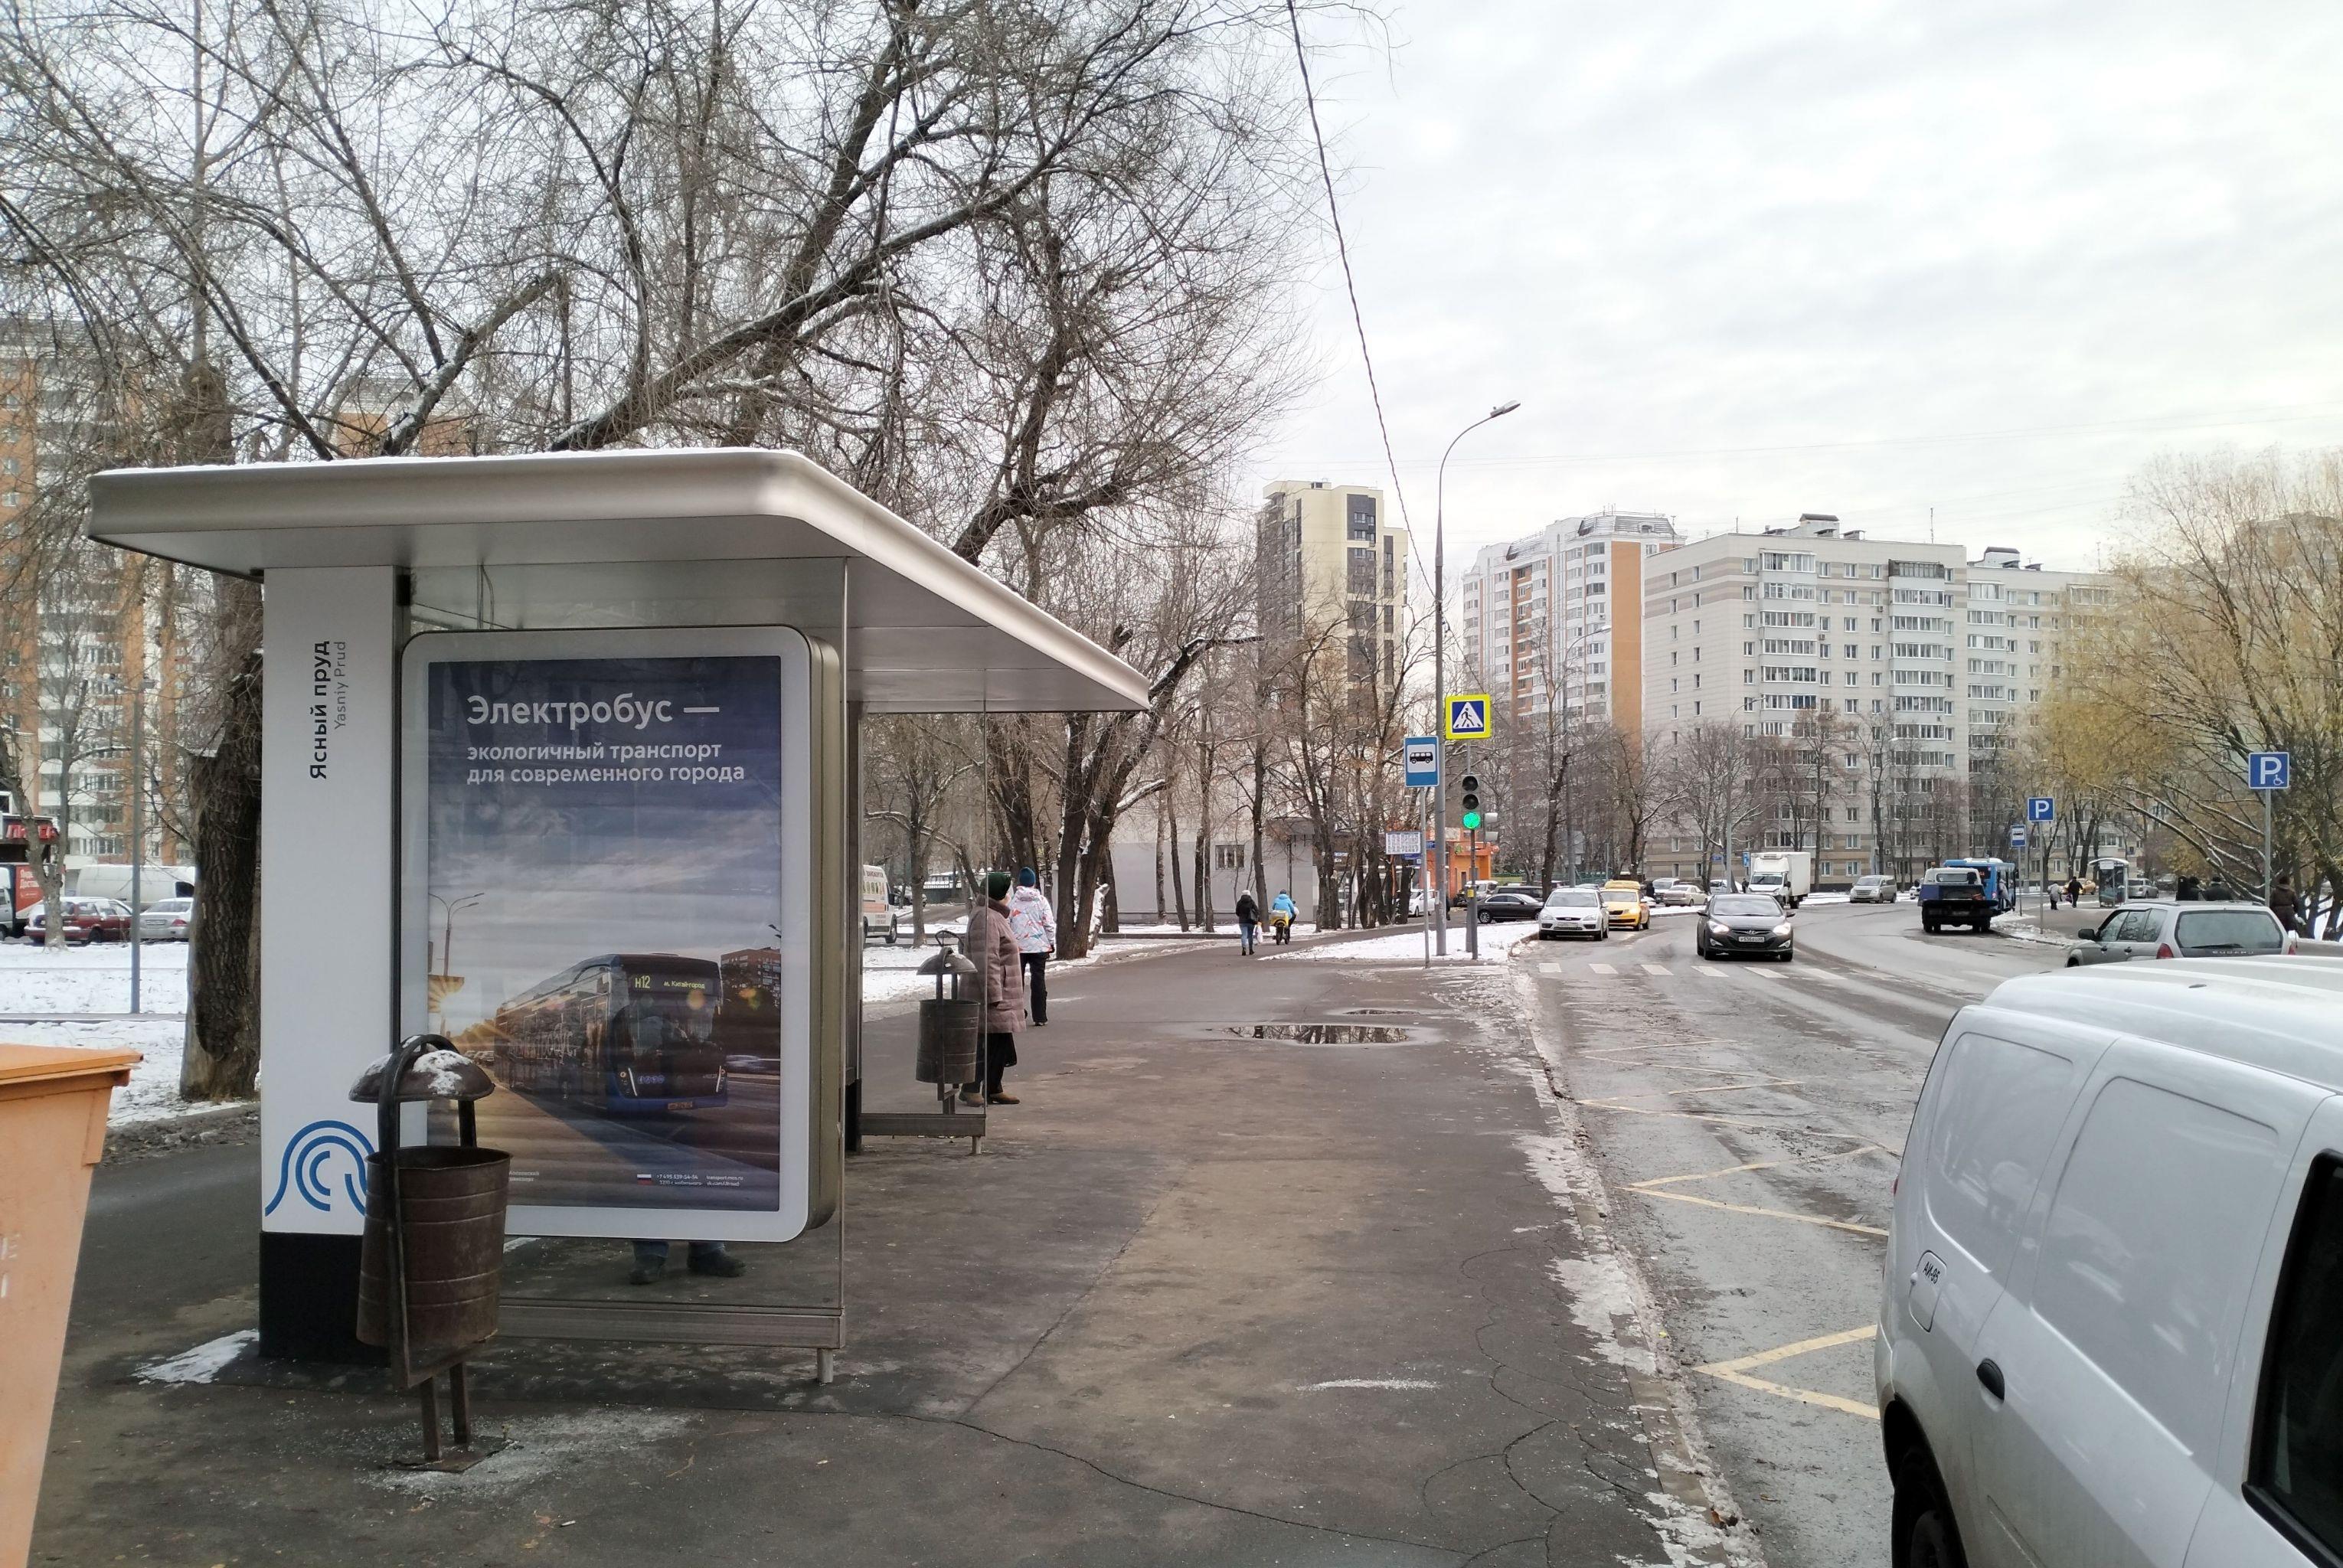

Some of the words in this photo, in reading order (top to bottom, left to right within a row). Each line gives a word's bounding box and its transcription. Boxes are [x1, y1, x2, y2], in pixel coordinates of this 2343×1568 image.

[314, 641, 332, 696] пруд
[334, 641, 347, 677] Prud
[334, 681, 349, 730] Yasniy
[466, 692, 673, 730] Электробус
[309, 704, 327, 779] Ясный
[466, 742, 604, 760] экологичный
[609, 743, 722, 763] транспорт
[466, 768, 505, 786] для
[510, 767, 664, 786] современного
[669, 766, 745, 784] города
[2260, 756, 2282, 785] P
[2035, 800, 2050, 819] P
